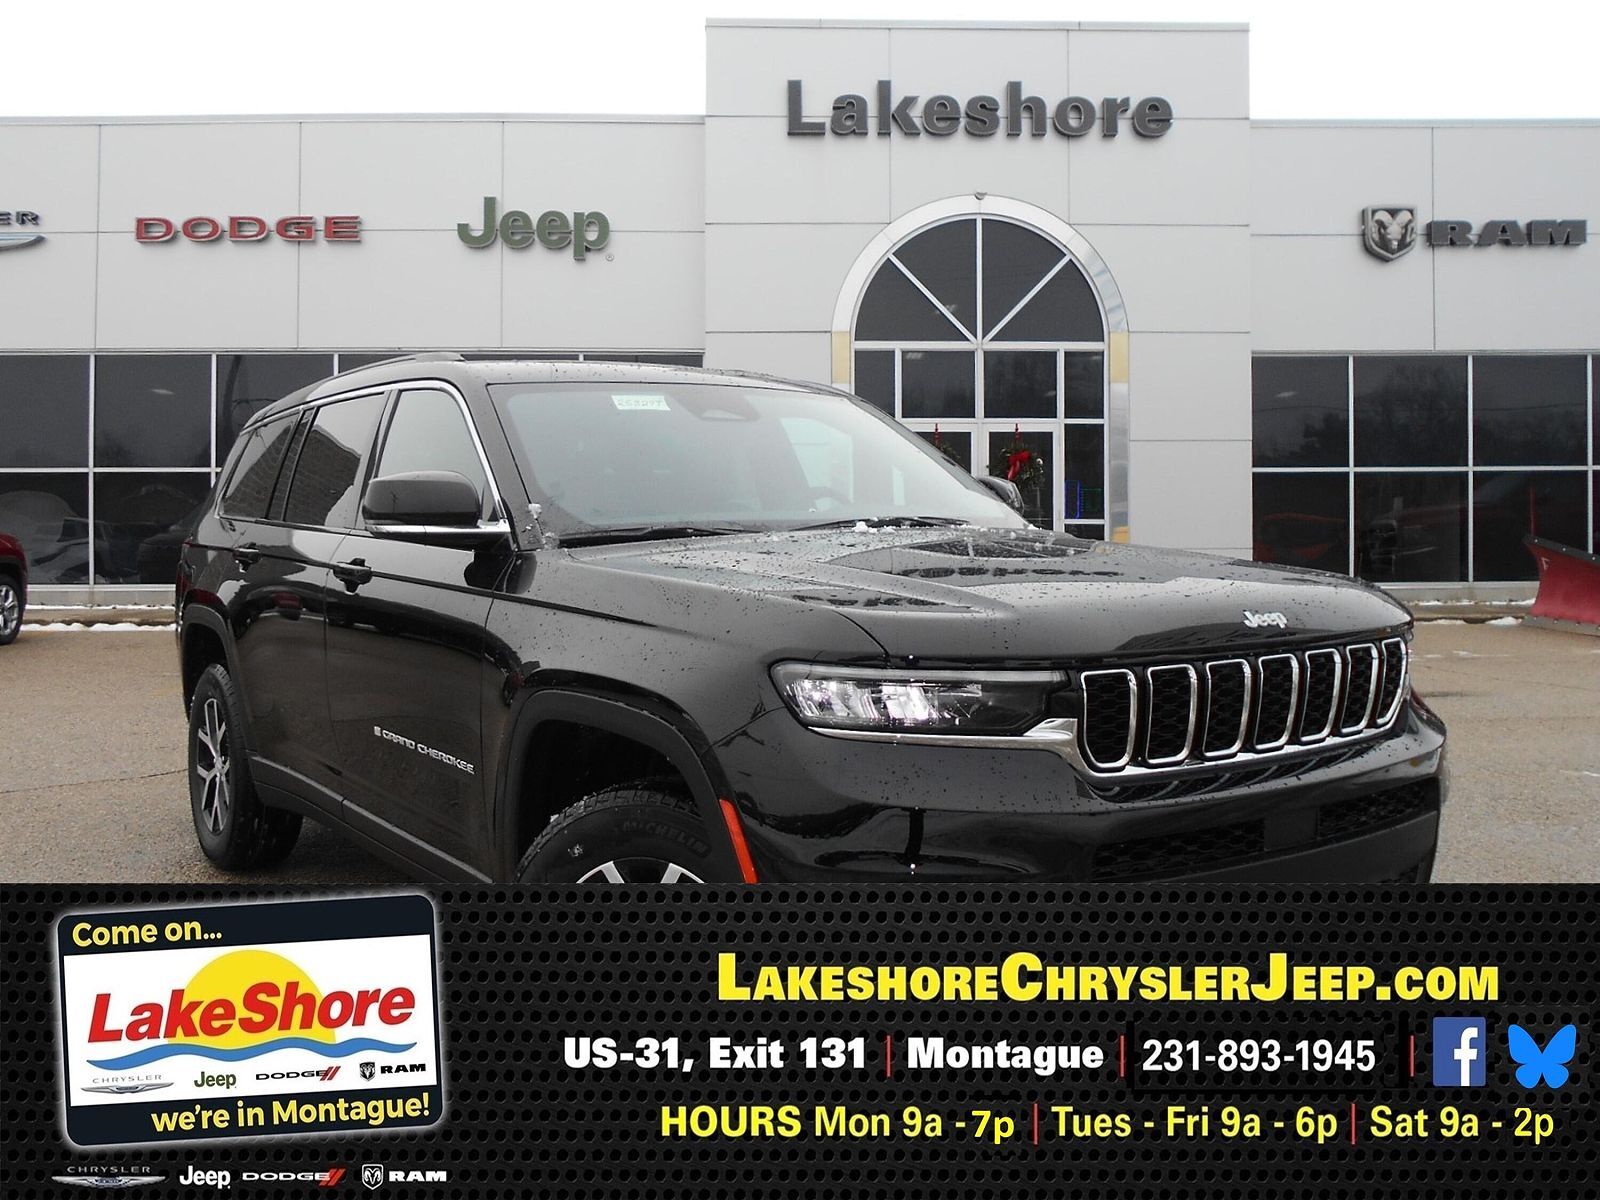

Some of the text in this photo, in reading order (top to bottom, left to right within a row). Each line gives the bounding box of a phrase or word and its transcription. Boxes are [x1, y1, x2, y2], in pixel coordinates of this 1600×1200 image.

[787, 79, 1173, 138] Lakeshore
[135, 215, 362, 243] DODGE
[456, 196, 611, 261] Jeep
[1427, 219, 1587, 247] RAM
[1243, 611, 1288, 629] Jeep
[382, 729, 475, 775] GRAND CHEROKEE
